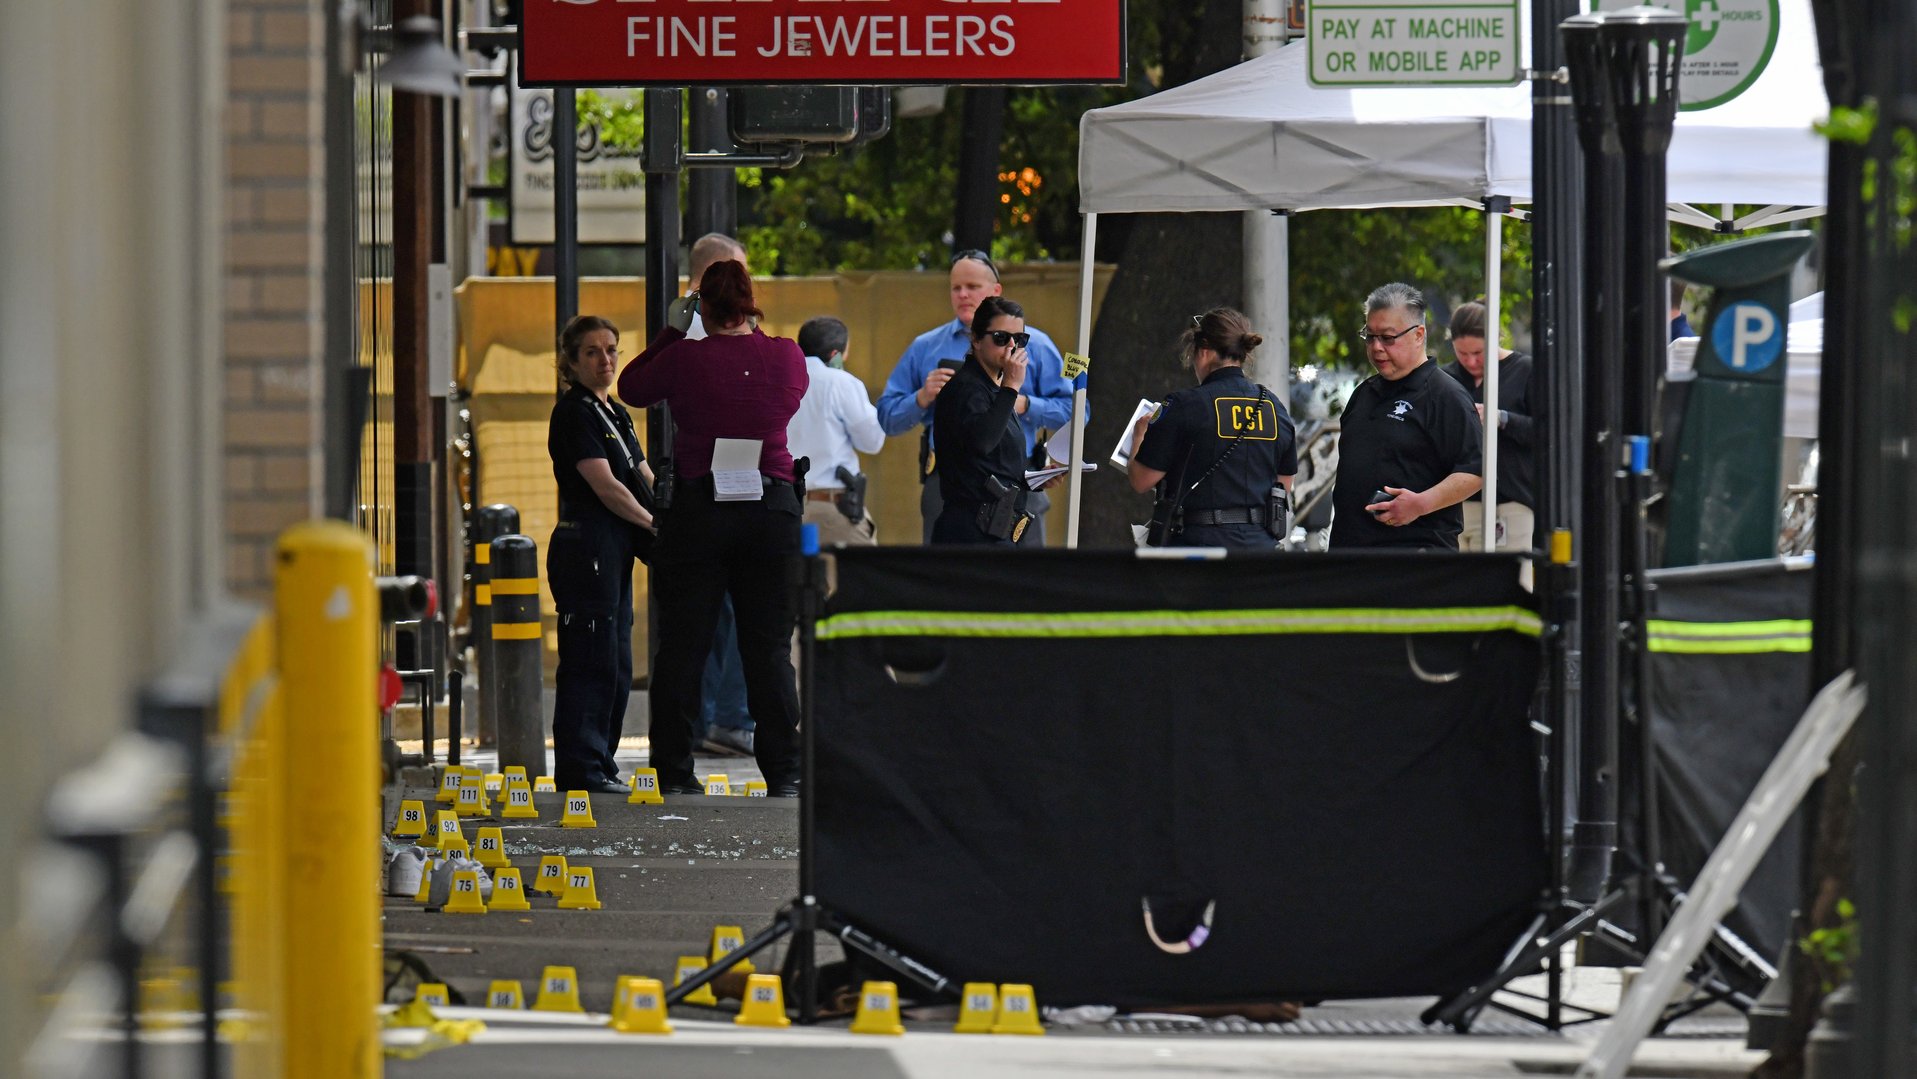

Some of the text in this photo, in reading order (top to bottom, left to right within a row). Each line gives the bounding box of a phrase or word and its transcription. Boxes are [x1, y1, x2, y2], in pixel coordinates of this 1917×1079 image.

[1721, 11, 1762, 21] HOURS
[1322, 17, 1504, 39] PAY AT MACHINE
[627, 14, 1016, 57] FINE JEWELERS
[1326, 50, 1501, 72] OR MOBILE APP
[1732, 305, 1775, 368] P
[1231, 405, 1264, 431] CSI
[638, 777, 654, 788] 115
[461, 789, 477, 800] 111
[709, 784, 725, 794] 136
[511, 791, 528, 802] 110
[569, 801, 586, 812] 109
[406, 810, 418, 821] 98
[428, 824, 437, 836] 92
[444, 821, 455, 832] 92
[482, 838, 494, 849] 81
[449, 850, 462, 859] 80
[546, 865, 558, 877] 79
[459, 879, 472, 891] 75
[501, 877, 514, 888] 76
[573, 875, 586, 887] 77
